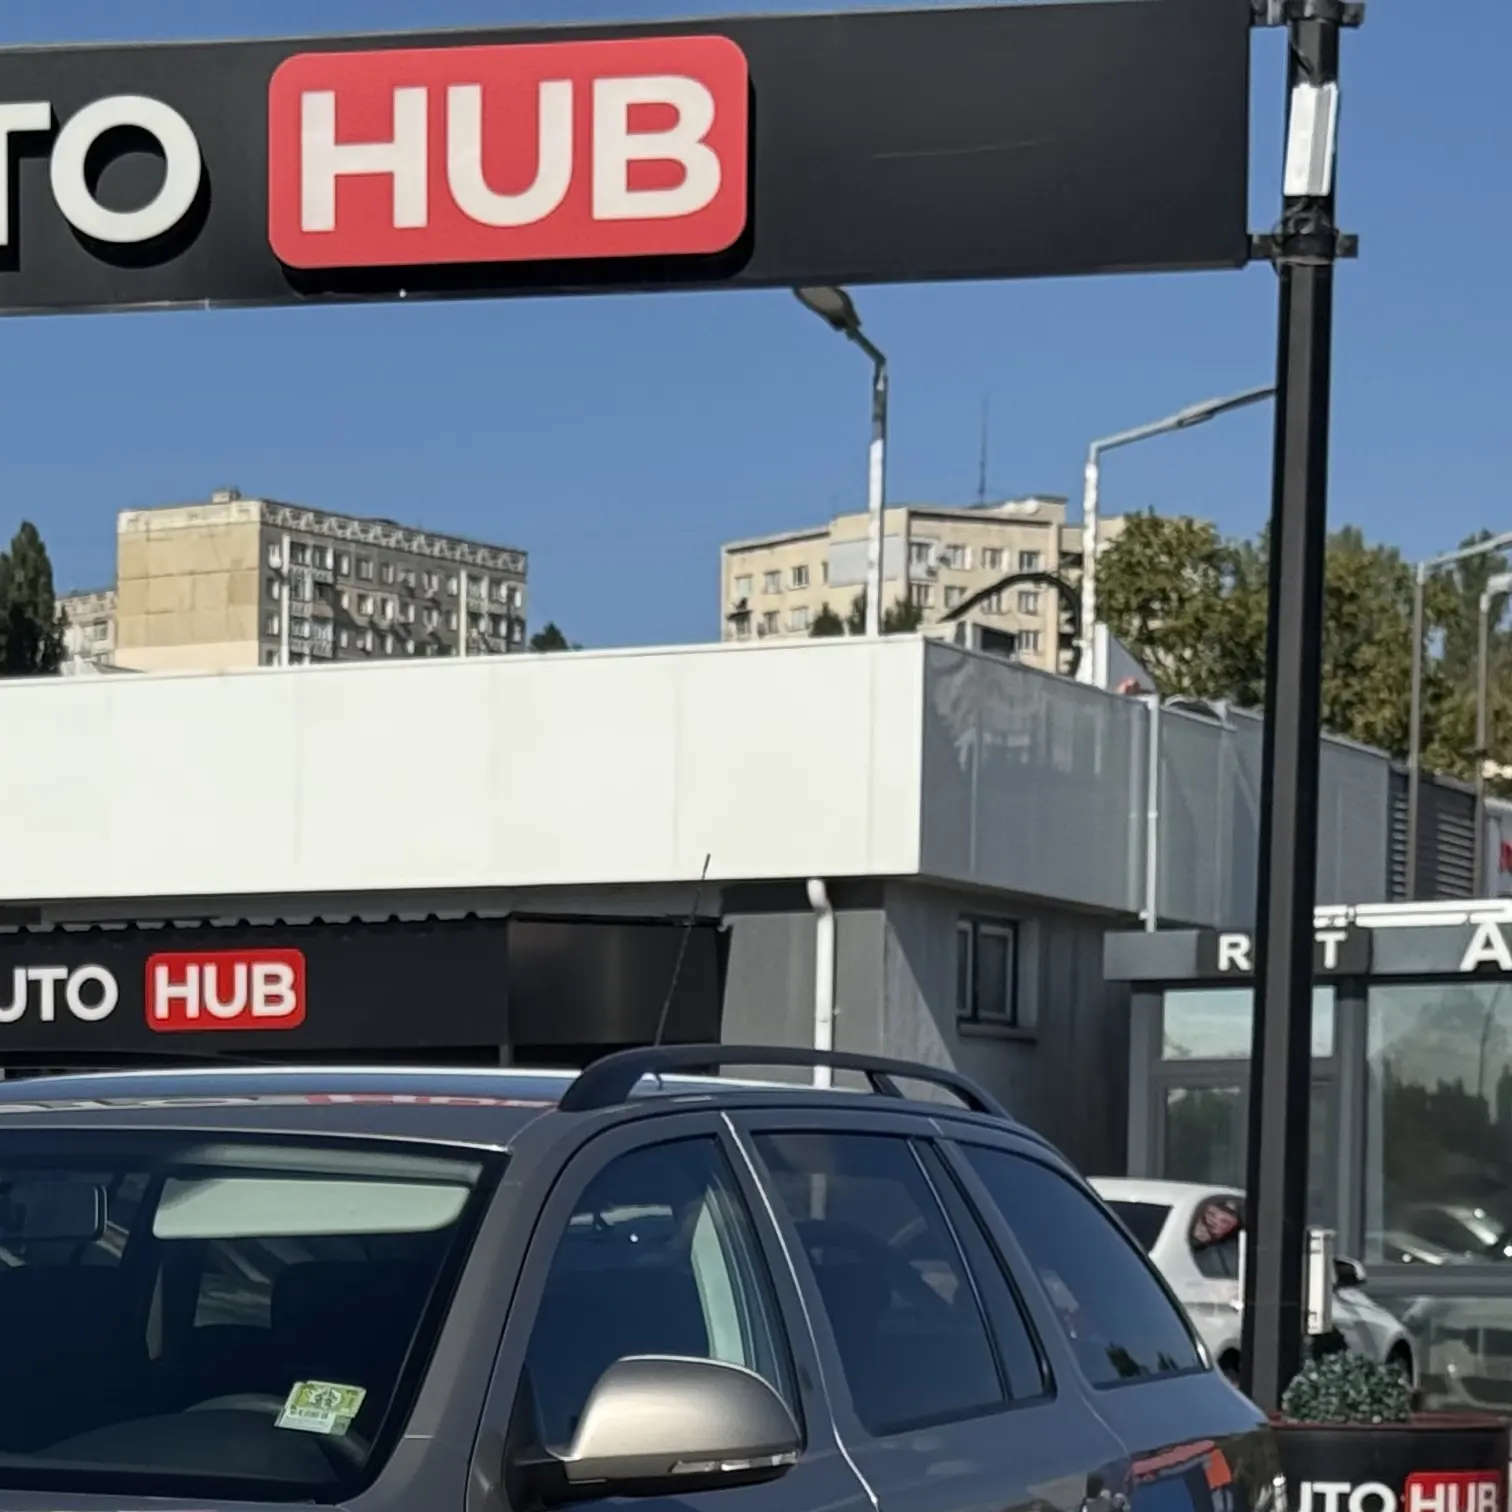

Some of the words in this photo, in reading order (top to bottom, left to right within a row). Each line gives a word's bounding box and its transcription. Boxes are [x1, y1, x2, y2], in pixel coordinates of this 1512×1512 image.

[300, 75, 721, 231] HUB
[1218, 933, 1347, 970] RT
[155, 963, 296, 1019] HUB
